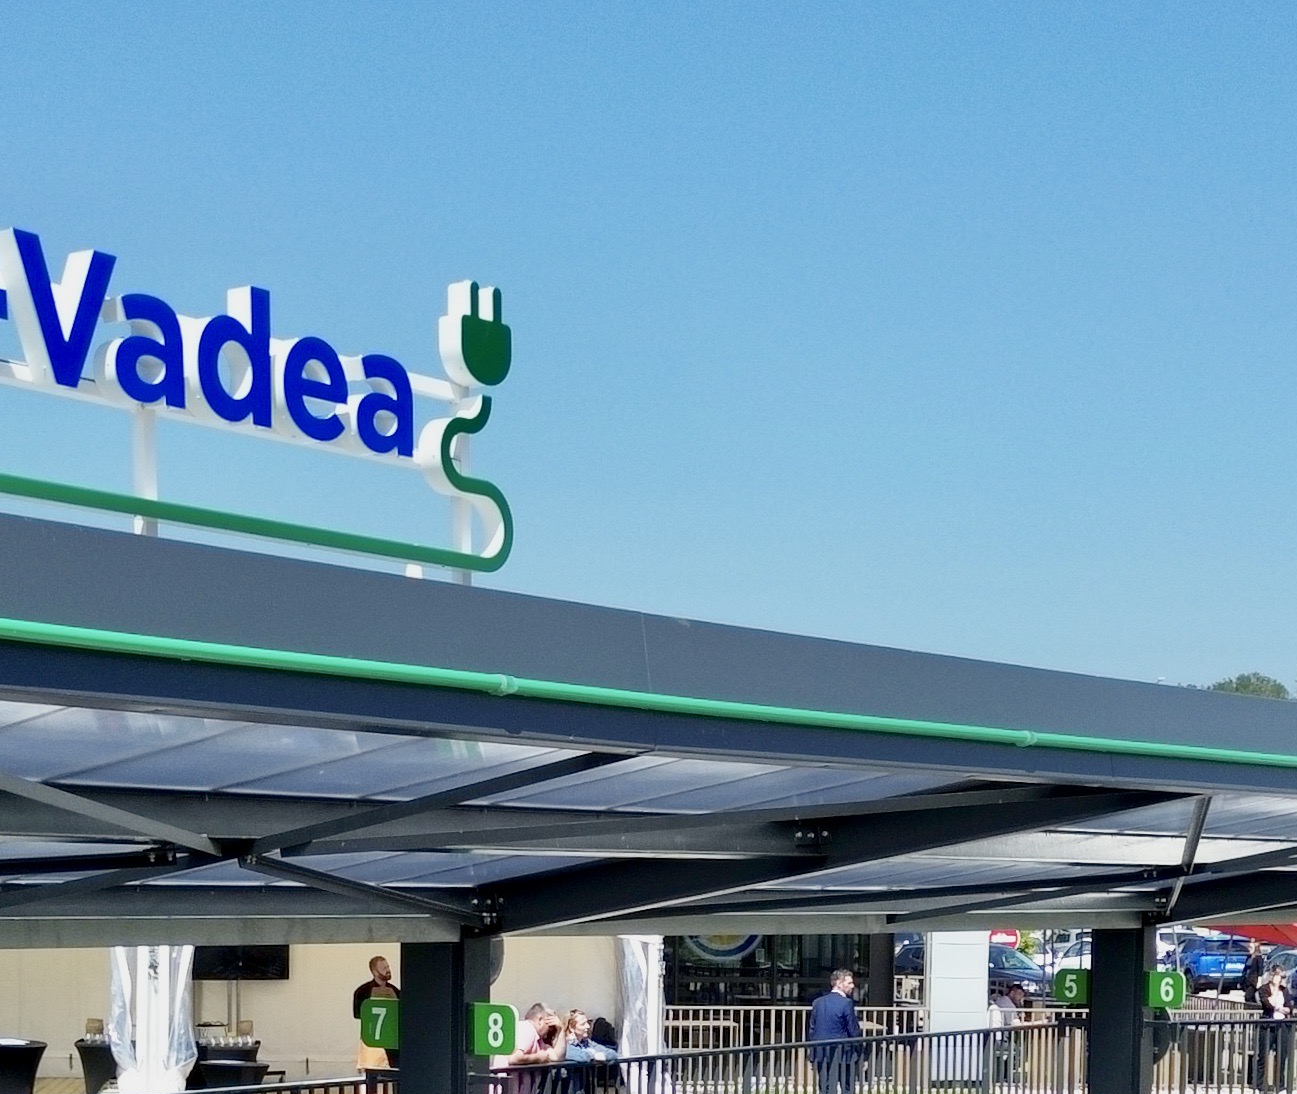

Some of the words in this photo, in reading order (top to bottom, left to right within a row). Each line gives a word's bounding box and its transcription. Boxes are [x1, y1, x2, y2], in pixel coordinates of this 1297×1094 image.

[1064, 974, 1078, 998] 5
[1159, 977, 1175, 1003] 6
[371, 1007, 387, 1041] 7
[487, 1012, 504, 1048] 8
